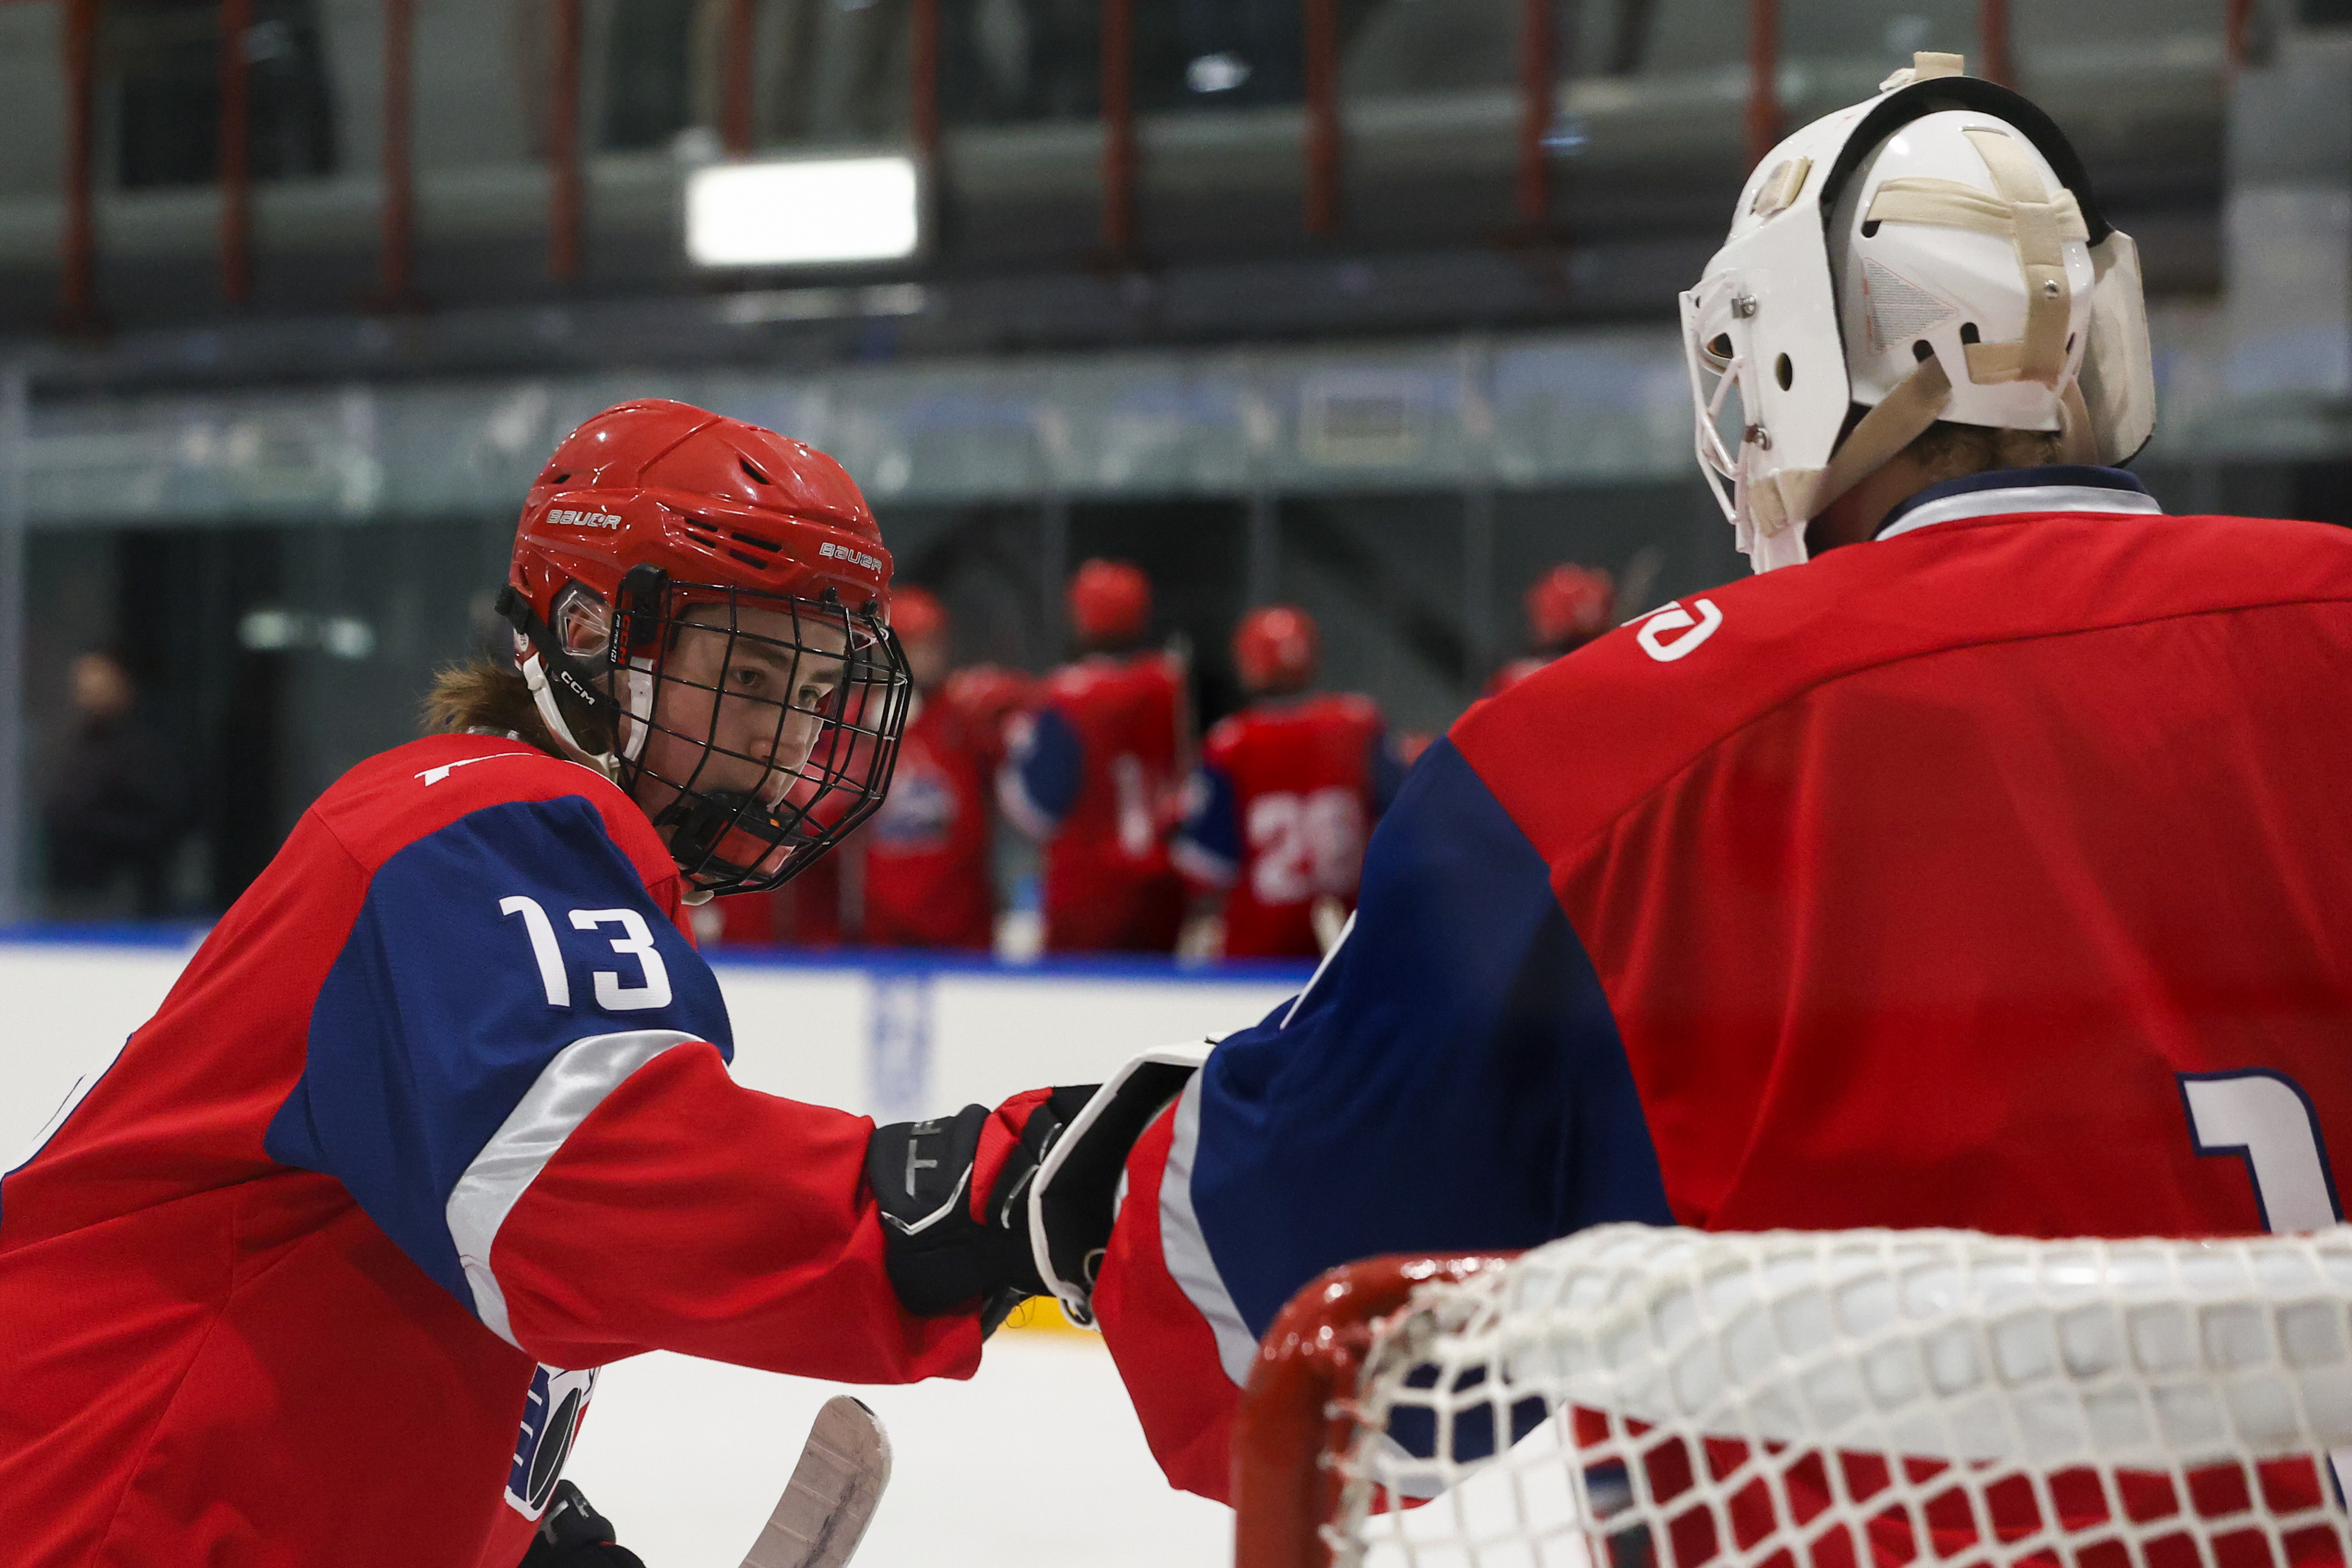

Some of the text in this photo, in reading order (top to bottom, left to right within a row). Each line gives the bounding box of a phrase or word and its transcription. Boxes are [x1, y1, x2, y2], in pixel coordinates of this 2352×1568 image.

[547, 509, 622, 530] BAUER
[819, 542, 883, 574] BAUER
[618, 614, 631, 665] CCM
[561, 670, 595, 705] CCM
[498, 895, 673, 1011] 13
